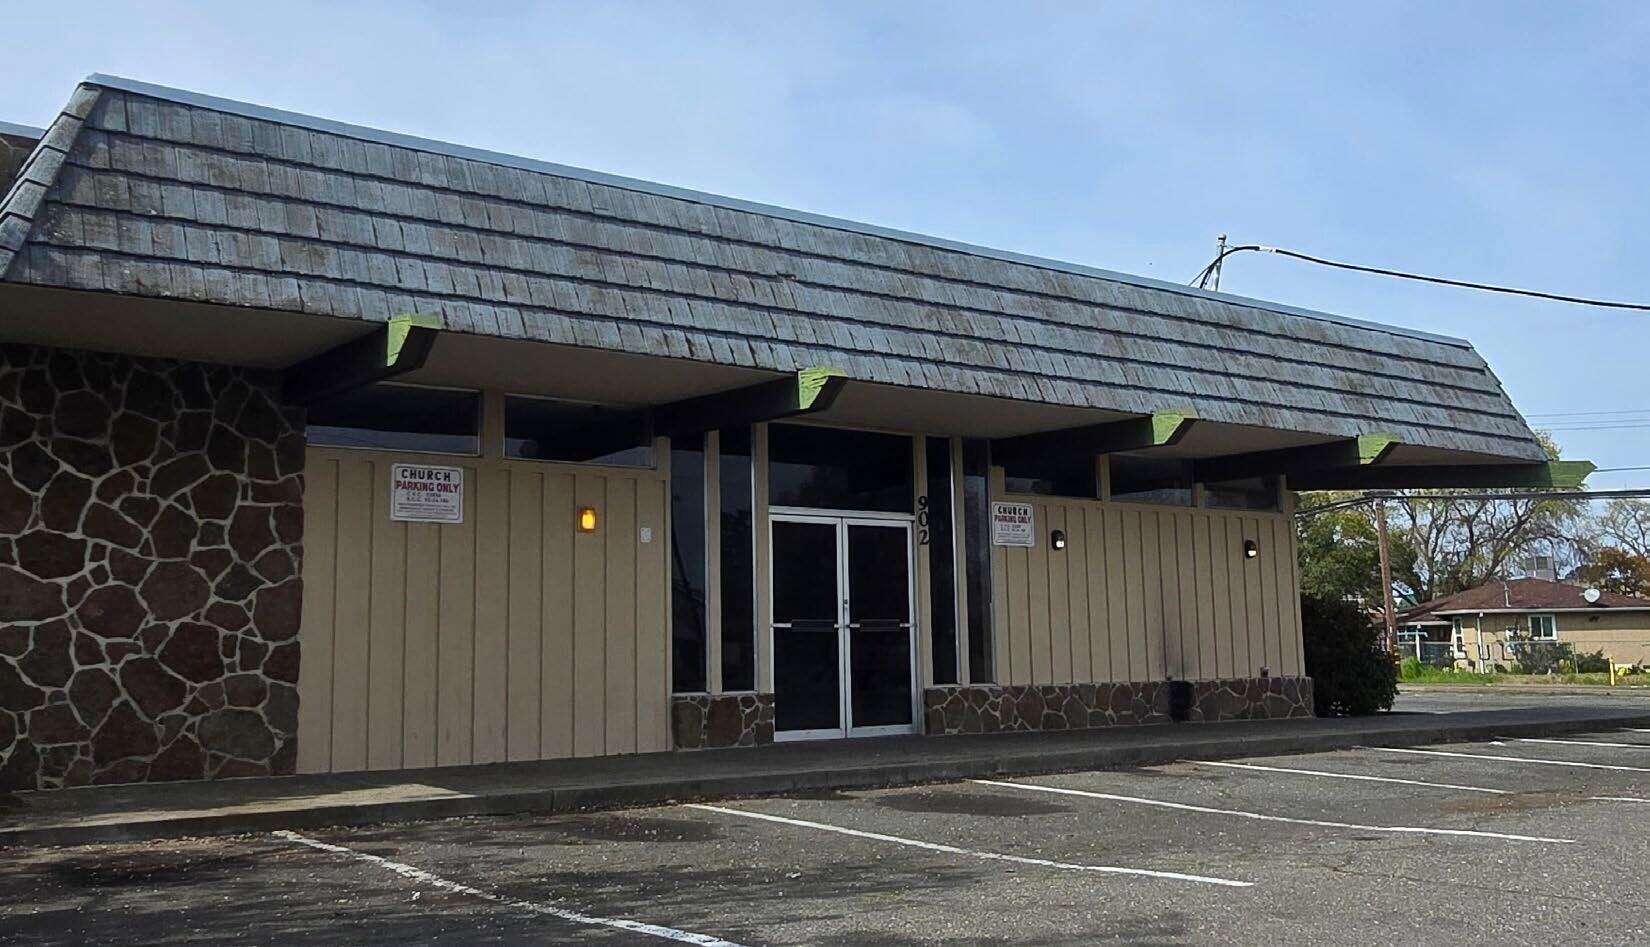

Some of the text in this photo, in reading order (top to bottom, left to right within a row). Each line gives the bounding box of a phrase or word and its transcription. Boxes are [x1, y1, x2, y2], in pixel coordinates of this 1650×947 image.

[401, 469, 451, 482] CHURCH
[395, 480, 460, 493] PARKING ONLY
[998, 506, 1028, 515] CHURCH
[918, 496, 929, 545] 902
